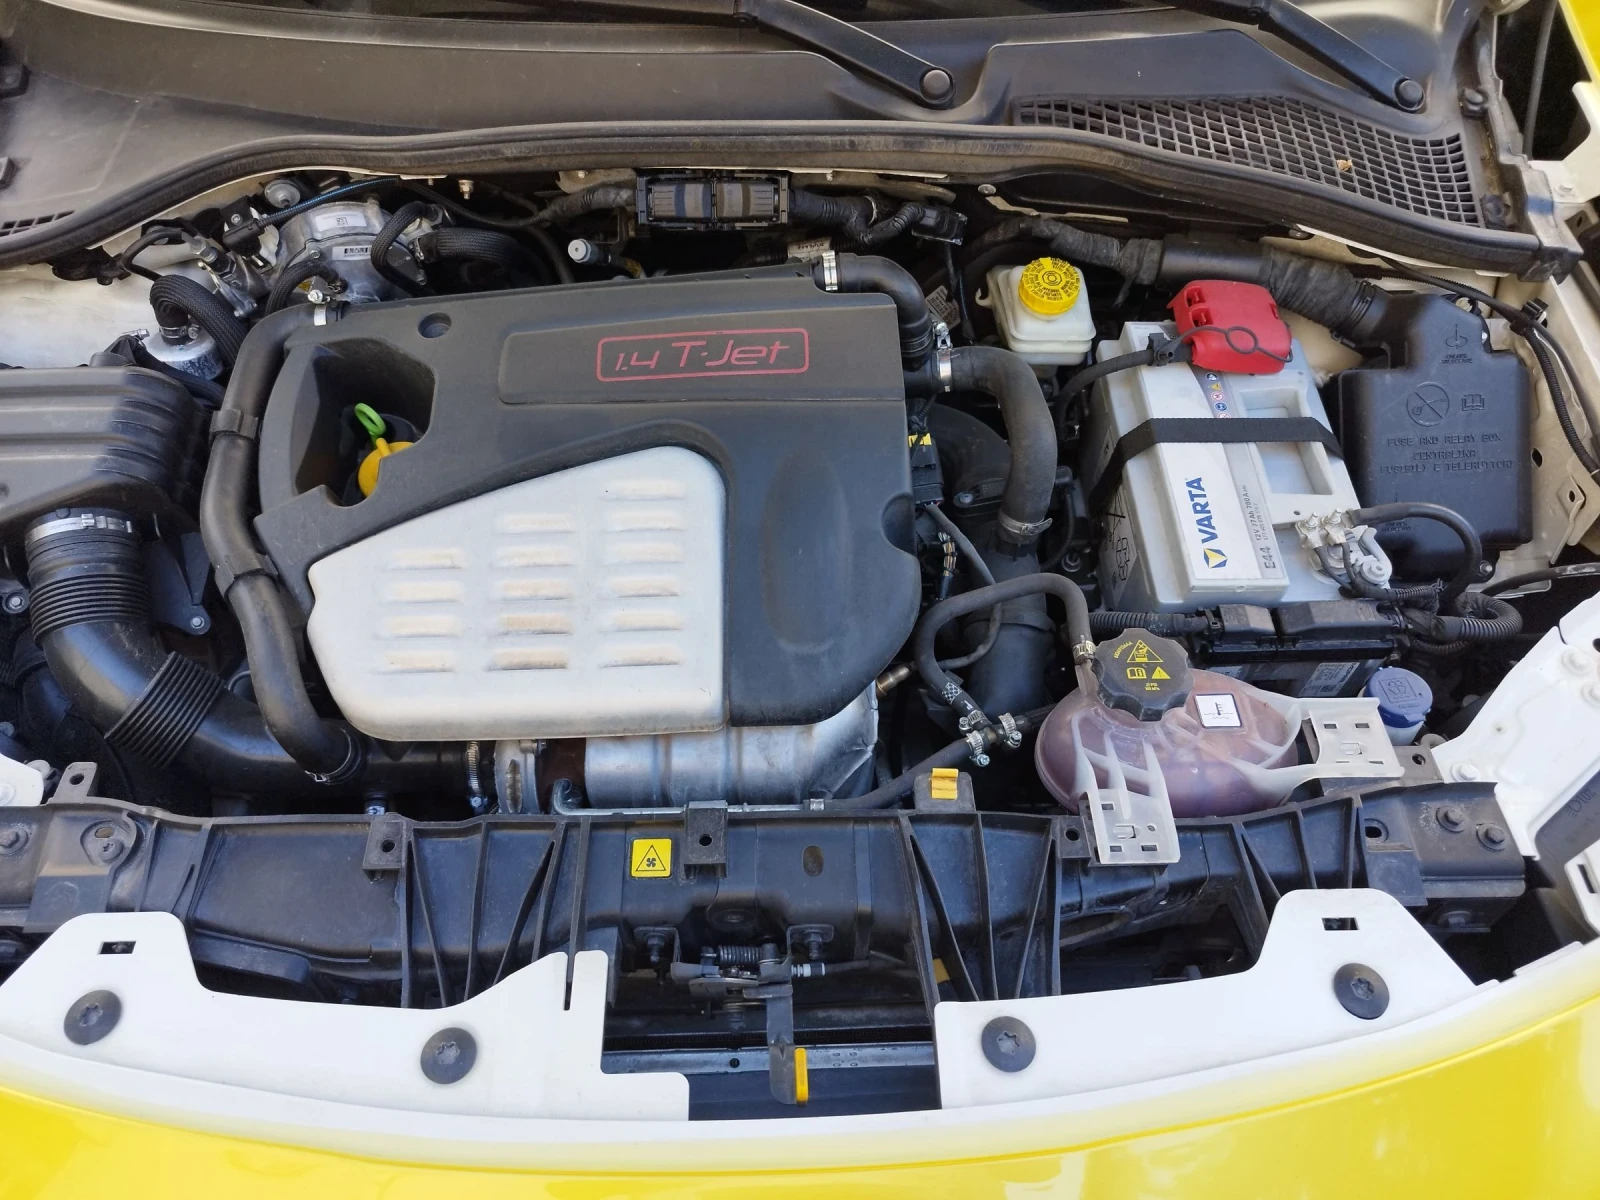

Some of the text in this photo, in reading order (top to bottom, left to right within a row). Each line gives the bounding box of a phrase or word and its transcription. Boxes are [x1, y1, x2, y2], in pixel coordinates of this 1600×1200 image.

[614, 350, 661, 371] 1.4
[1387, 432, 1502, 447] FUSE AND RELAY BOX
[1433, 462, 1441, 472] E
[1185, 476, 1219, 544] VARTA
[1259, 545, 1277, 569] E44
